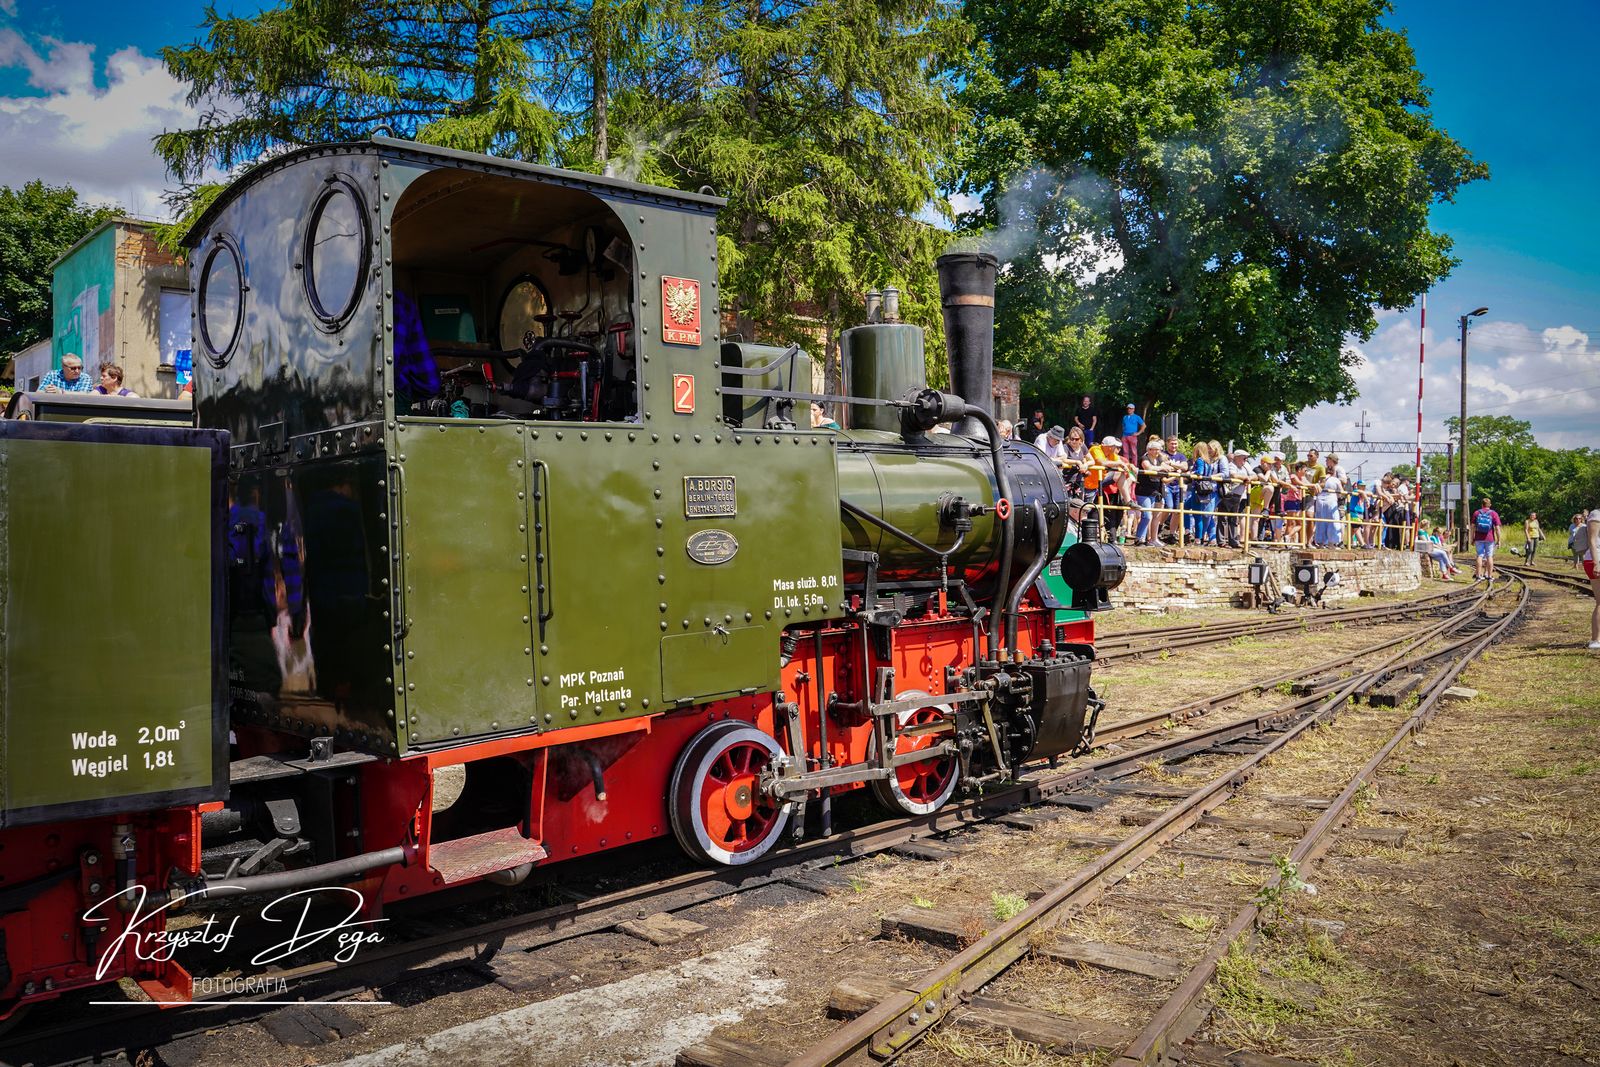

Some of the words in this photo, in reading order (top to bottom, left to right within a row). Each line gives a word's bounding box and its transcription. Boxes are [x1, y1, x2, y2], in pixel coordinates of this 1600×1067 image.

[676, 377, 692, 409] 2
[688, 493, 734, 502] BERLIN-TEGEL
[773, 578, 795, 591] Masa
[821, 575, 838, 588] 8,0t
[787, 595, 802, 608] lok.
[803, 593, 824, 606] 5,6m
[560, 672, 586, 688] MPK
[589, 667, 625, 684] Poznań
[560, 694, 582, 709] Par.
[585, 686, 632, 705] Maltanka
[71, 730, 118, 750] Woda
[71, 754, 129, 778] Węgiel
[143, 750, 175, 771] 1,8t
